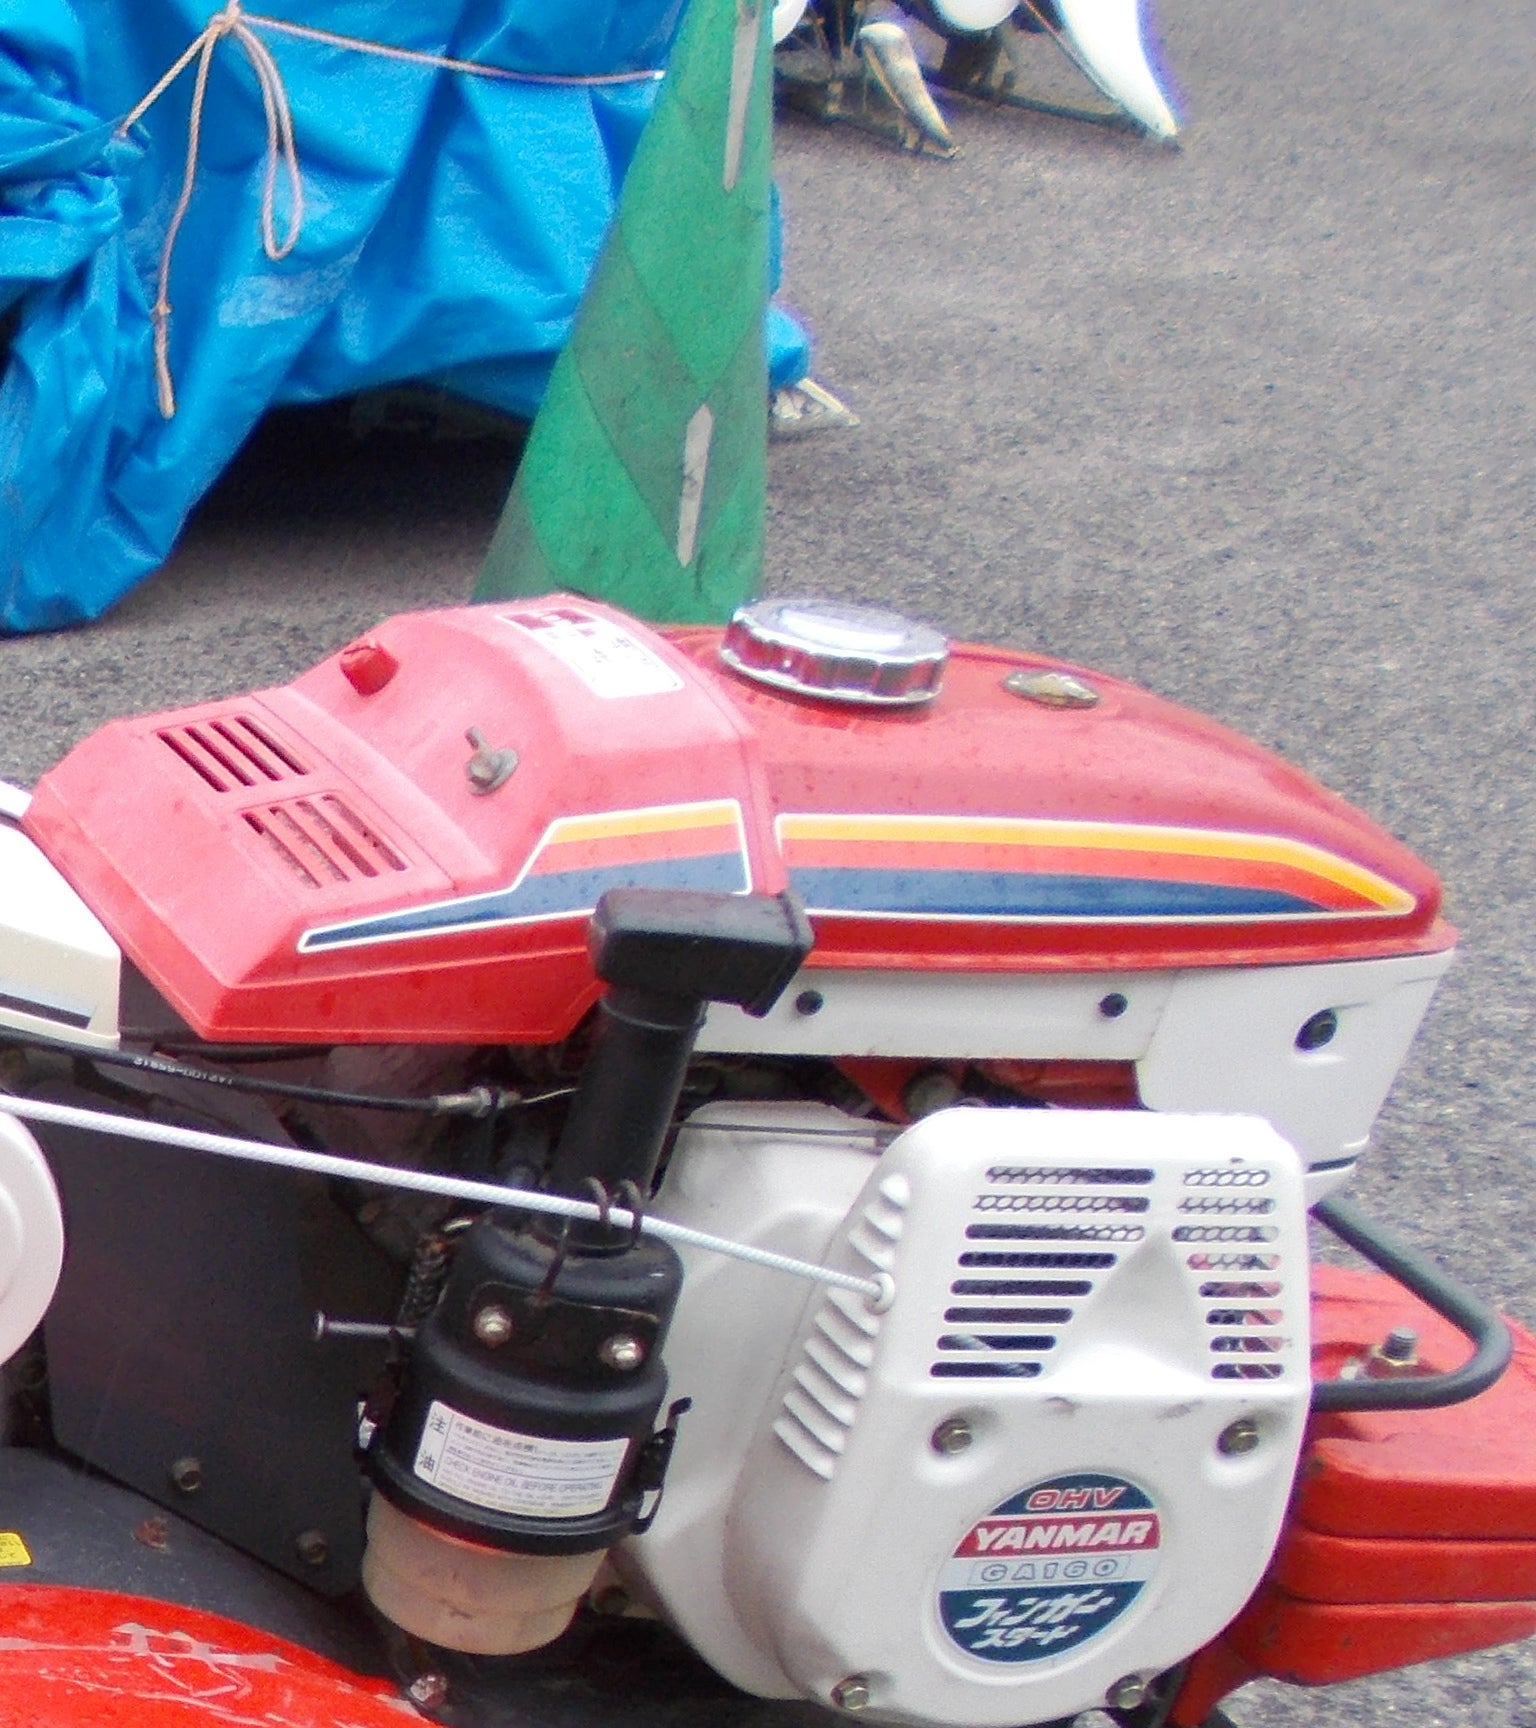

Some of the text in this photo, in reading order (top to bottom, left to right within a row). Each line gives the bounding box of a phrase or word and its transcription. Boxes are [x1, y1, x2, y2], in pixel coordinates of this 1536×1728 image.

[1026, 1486, 1127, 1511] OHV
[974, 1521, 1151, 1552] YANMAR
[980, 1559, 1118, 1582] GA160
[970, 1625, 1080, 1649] スタート
